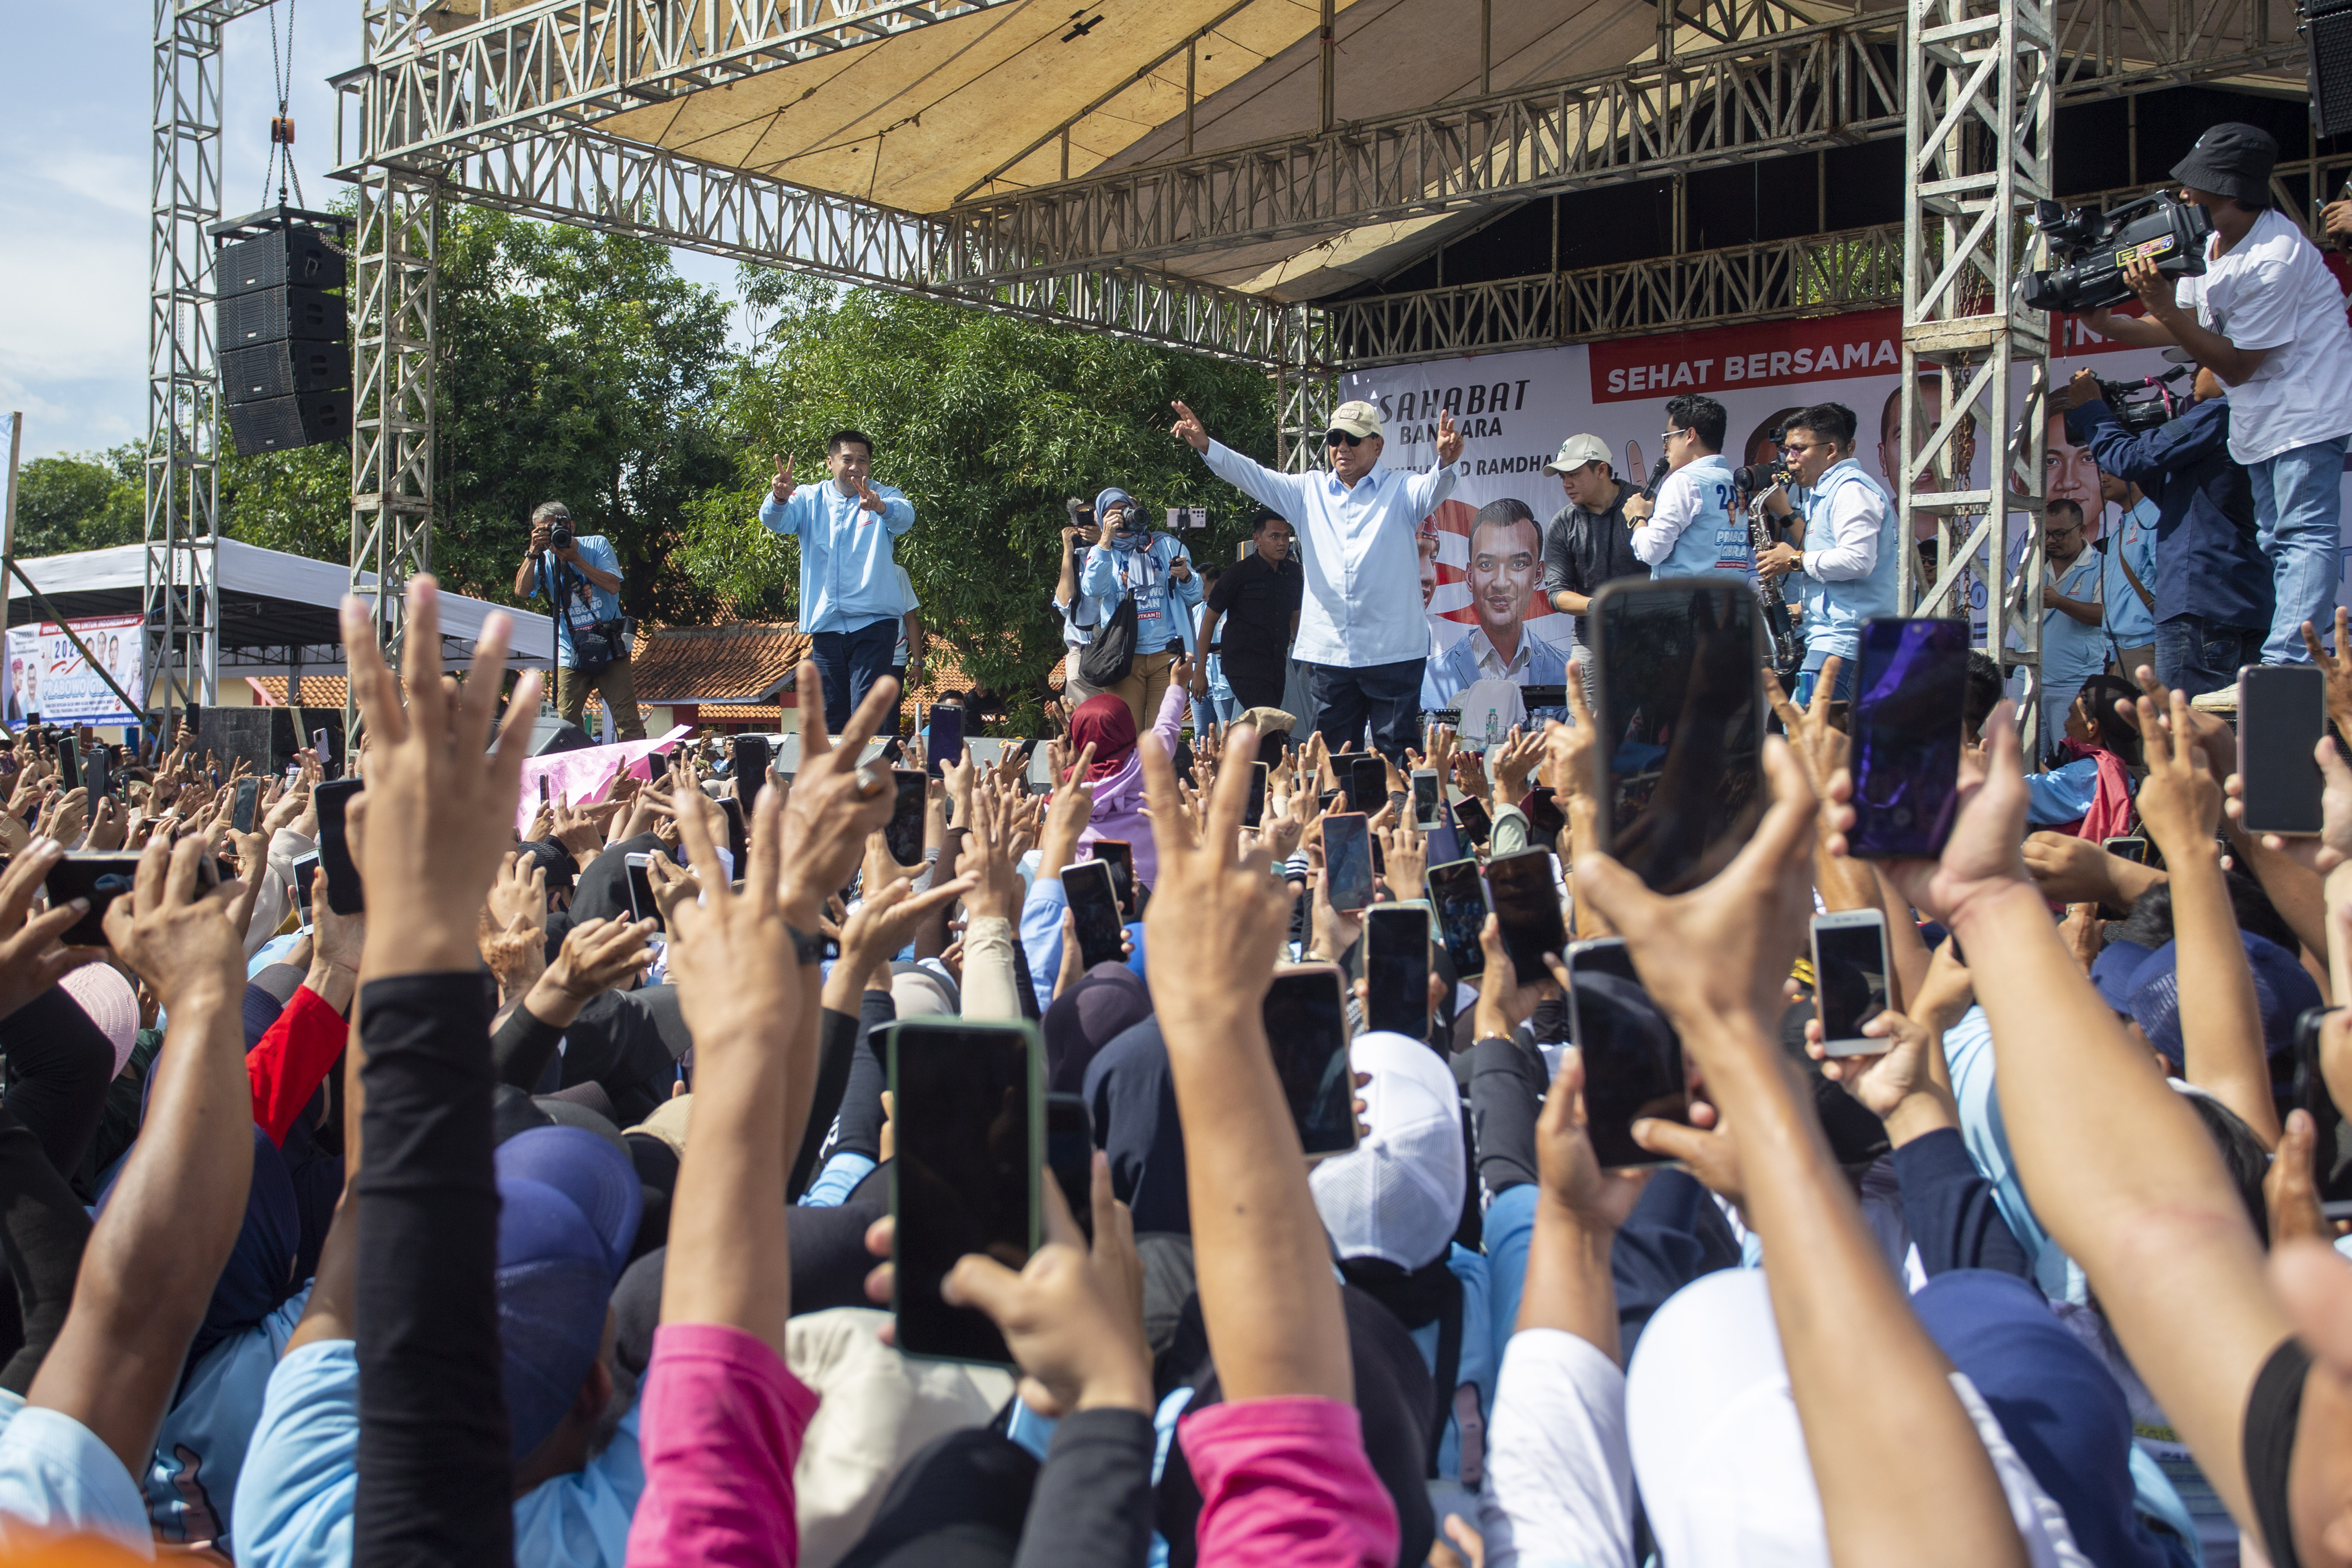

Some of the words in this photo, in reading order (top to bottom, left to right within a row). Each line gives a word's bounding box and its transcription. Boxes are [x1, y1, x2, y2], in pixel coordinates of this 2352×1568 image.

[1607, 358, 1714, 393] SEHAT
[1724, 339, 1899, 382] BERSAMA
[1379, 380, 1530, 424] SAHABAT
[1400, 417, 1502, 445] BANARA
[1476, 454, 1559, 476] RAMDHA
[1715, 530, 1749, 545] PRABO
[1721, 545, 1749, 560] GIBRA
[564, 610, 601, 626] IBRAN
[567, 599, 602, 616] ABOWO
[43, 677, 86, 700] PRABOWO
